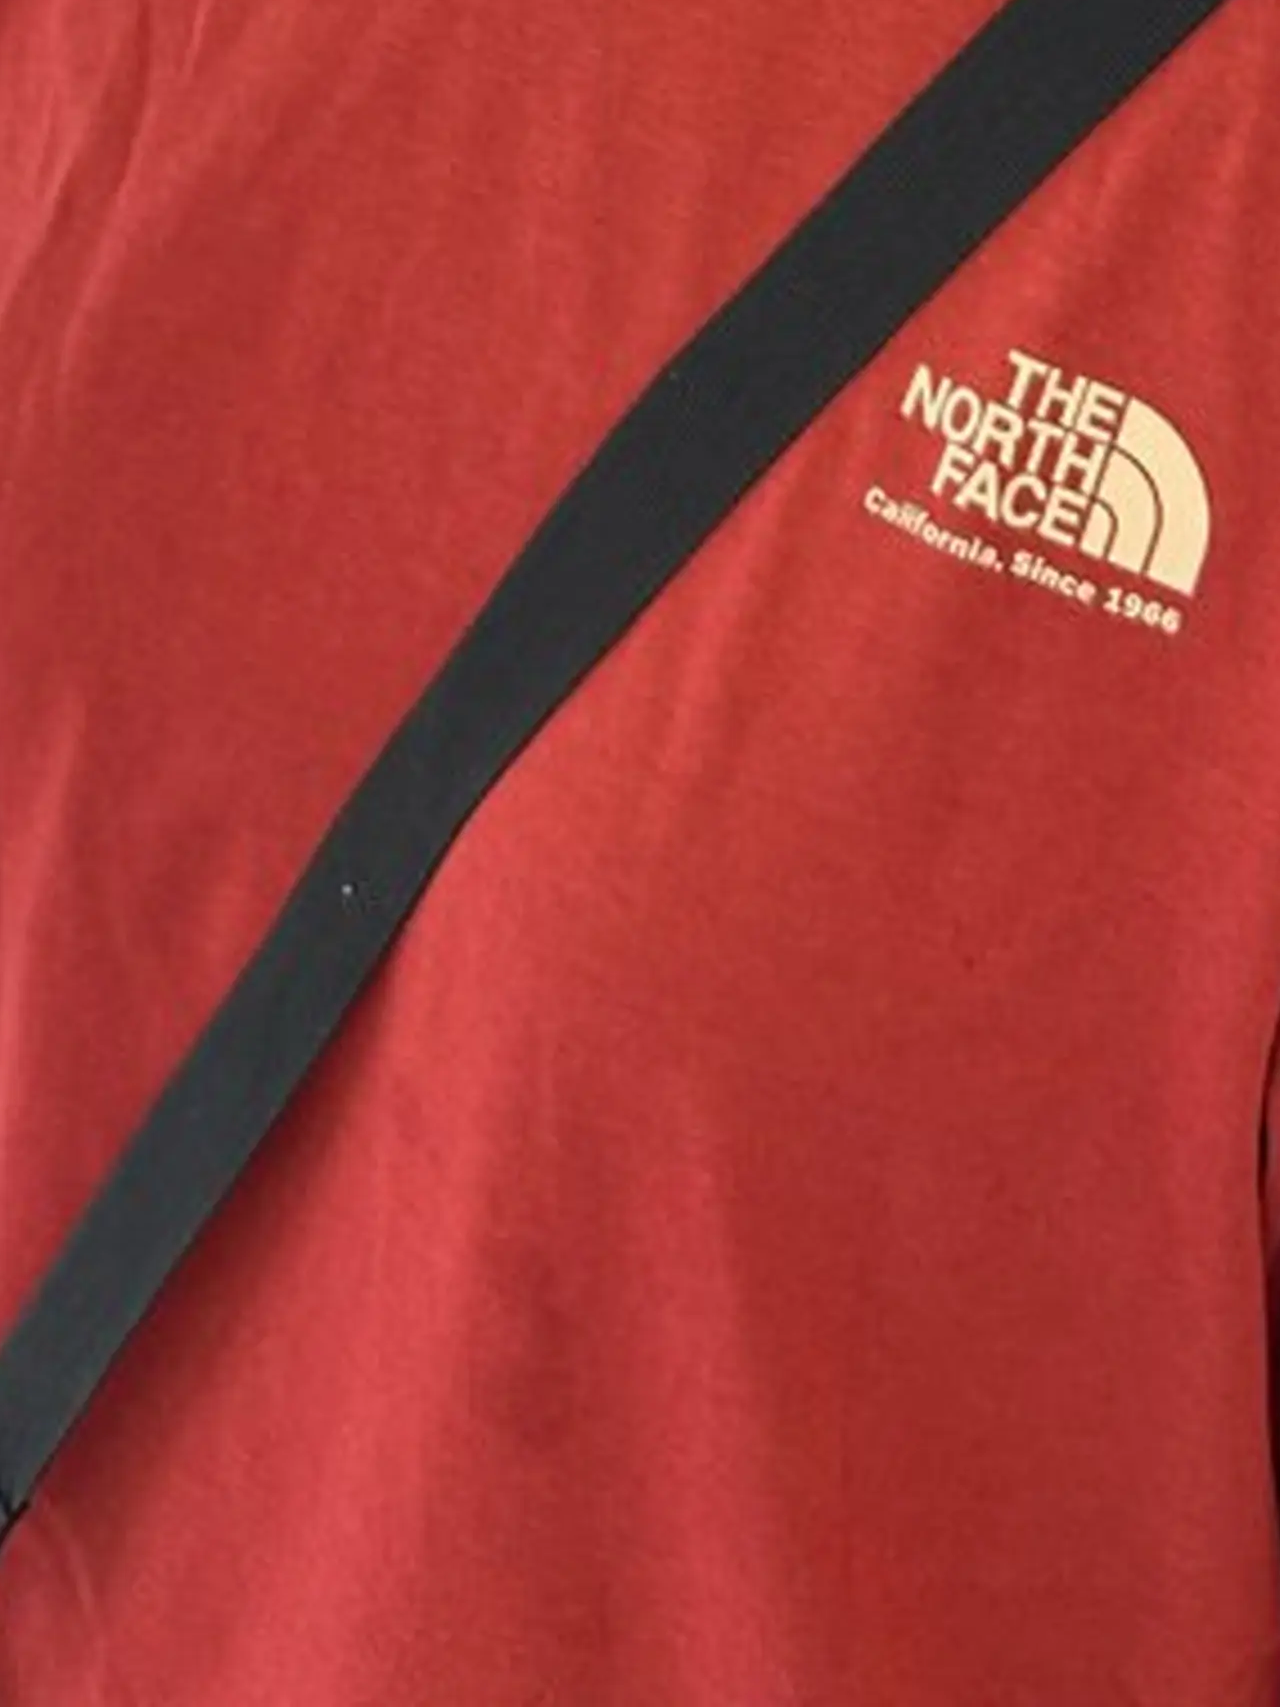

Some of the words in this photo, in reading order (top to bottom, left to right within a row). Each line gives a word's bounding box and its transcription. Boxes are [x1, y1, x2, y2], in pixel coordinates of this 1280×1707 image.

[900, 363, 1106, 497] NORTH
[1009, 348, 1125, 441] THE
[931, 443, 1087, 547] FACE
[1010, 550, 1097, 604] Since
[1103, 587, 1182, 634] 1966
